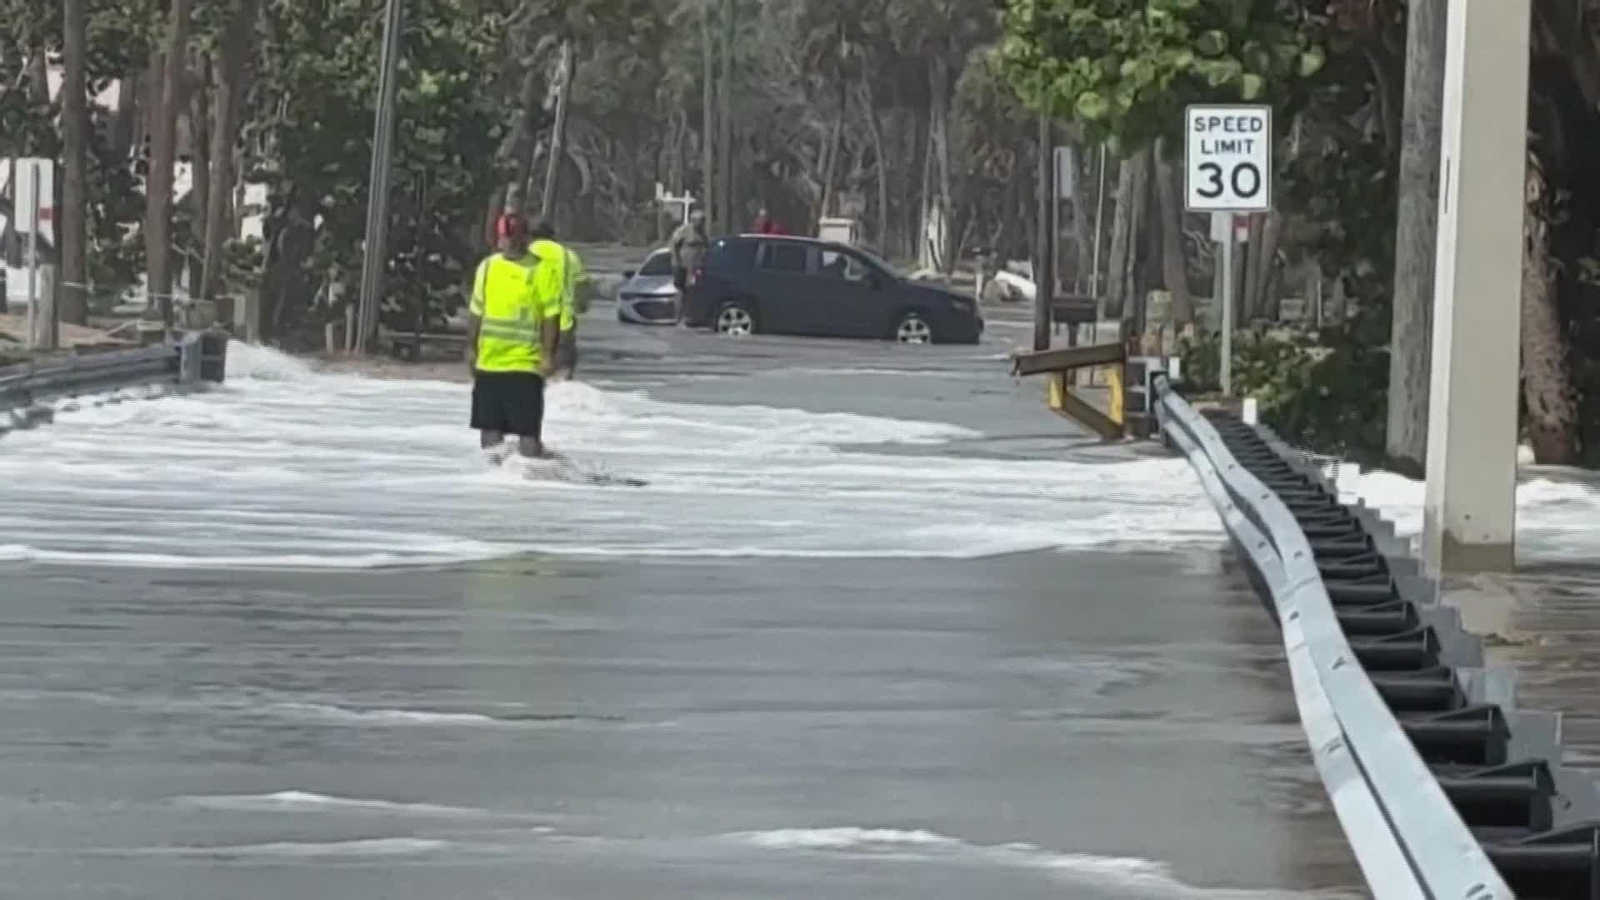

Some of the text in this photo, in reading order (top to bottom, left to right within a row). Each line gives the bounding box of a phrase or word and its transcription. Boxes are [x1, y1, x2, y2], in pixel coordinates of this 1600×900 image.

[1194, 116, 1263, 132] SPEED
[1200, 138, 1254, 155] LIMIT
[1196, 162, 1261, 198] 30
